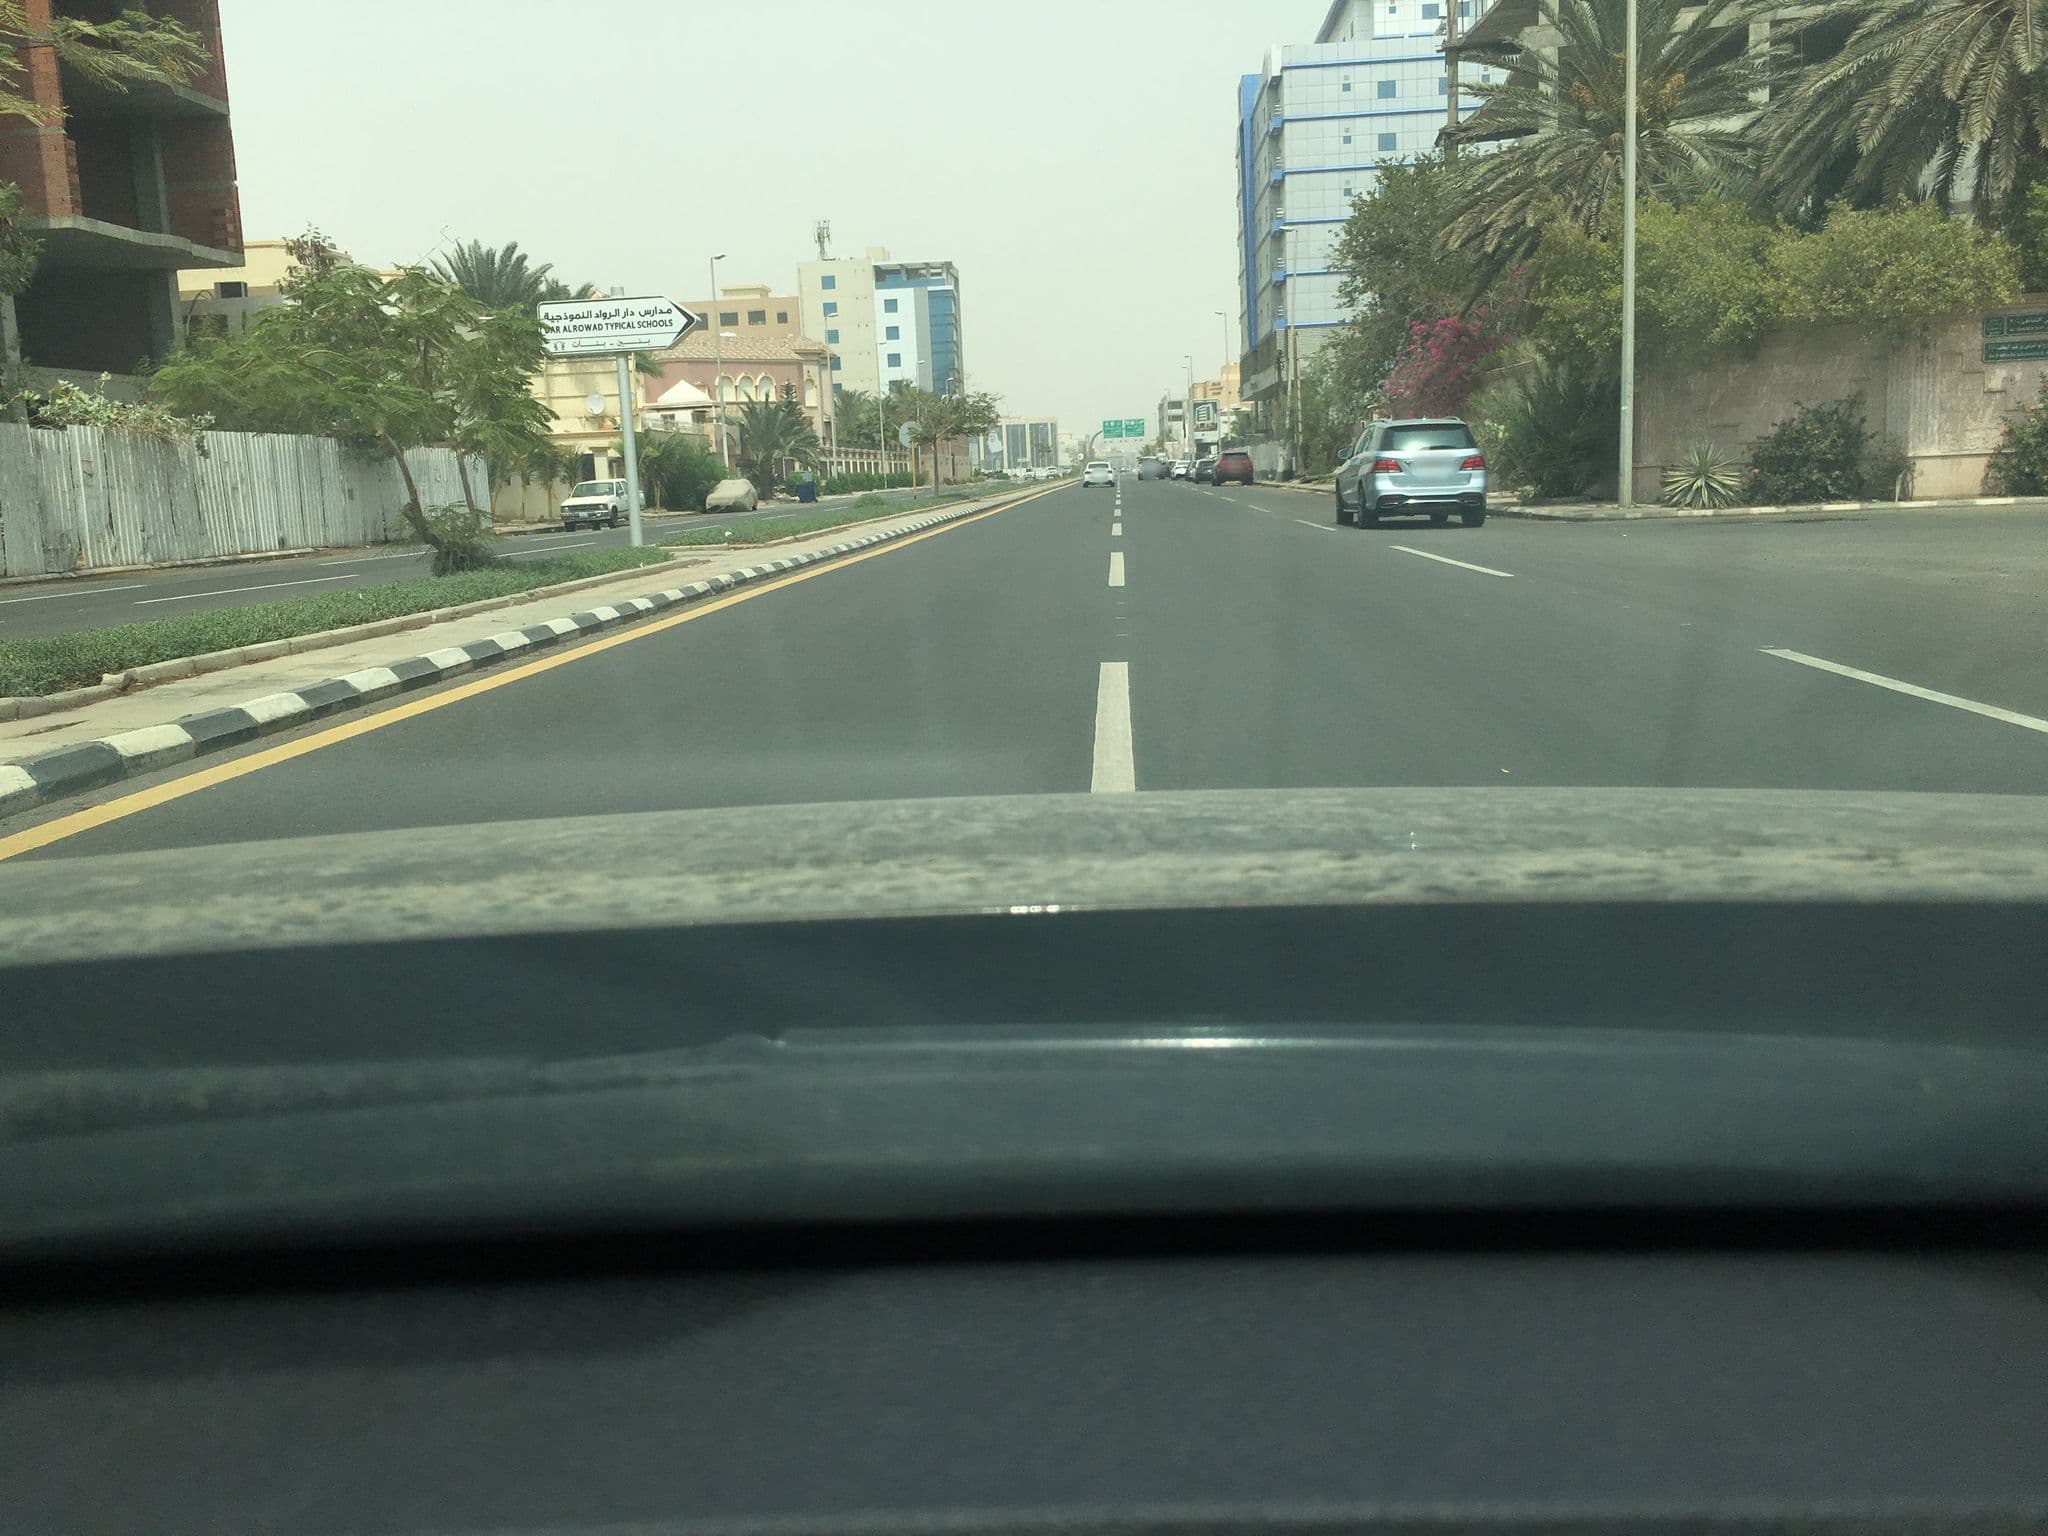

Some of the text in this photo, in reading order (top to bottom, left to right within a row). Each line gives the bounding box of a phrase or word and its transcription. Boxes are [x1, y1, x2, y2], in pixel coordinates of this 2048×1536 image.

[543, 306, 673, 323] مدارس دار الرواد النموذجية
[605, 321, 636, 330] TYPICAL
[636, 318, 673, 329] SCHOOLS
[571, 340, 606, 348] بنات
[616, 338, 651, 347] بنين
